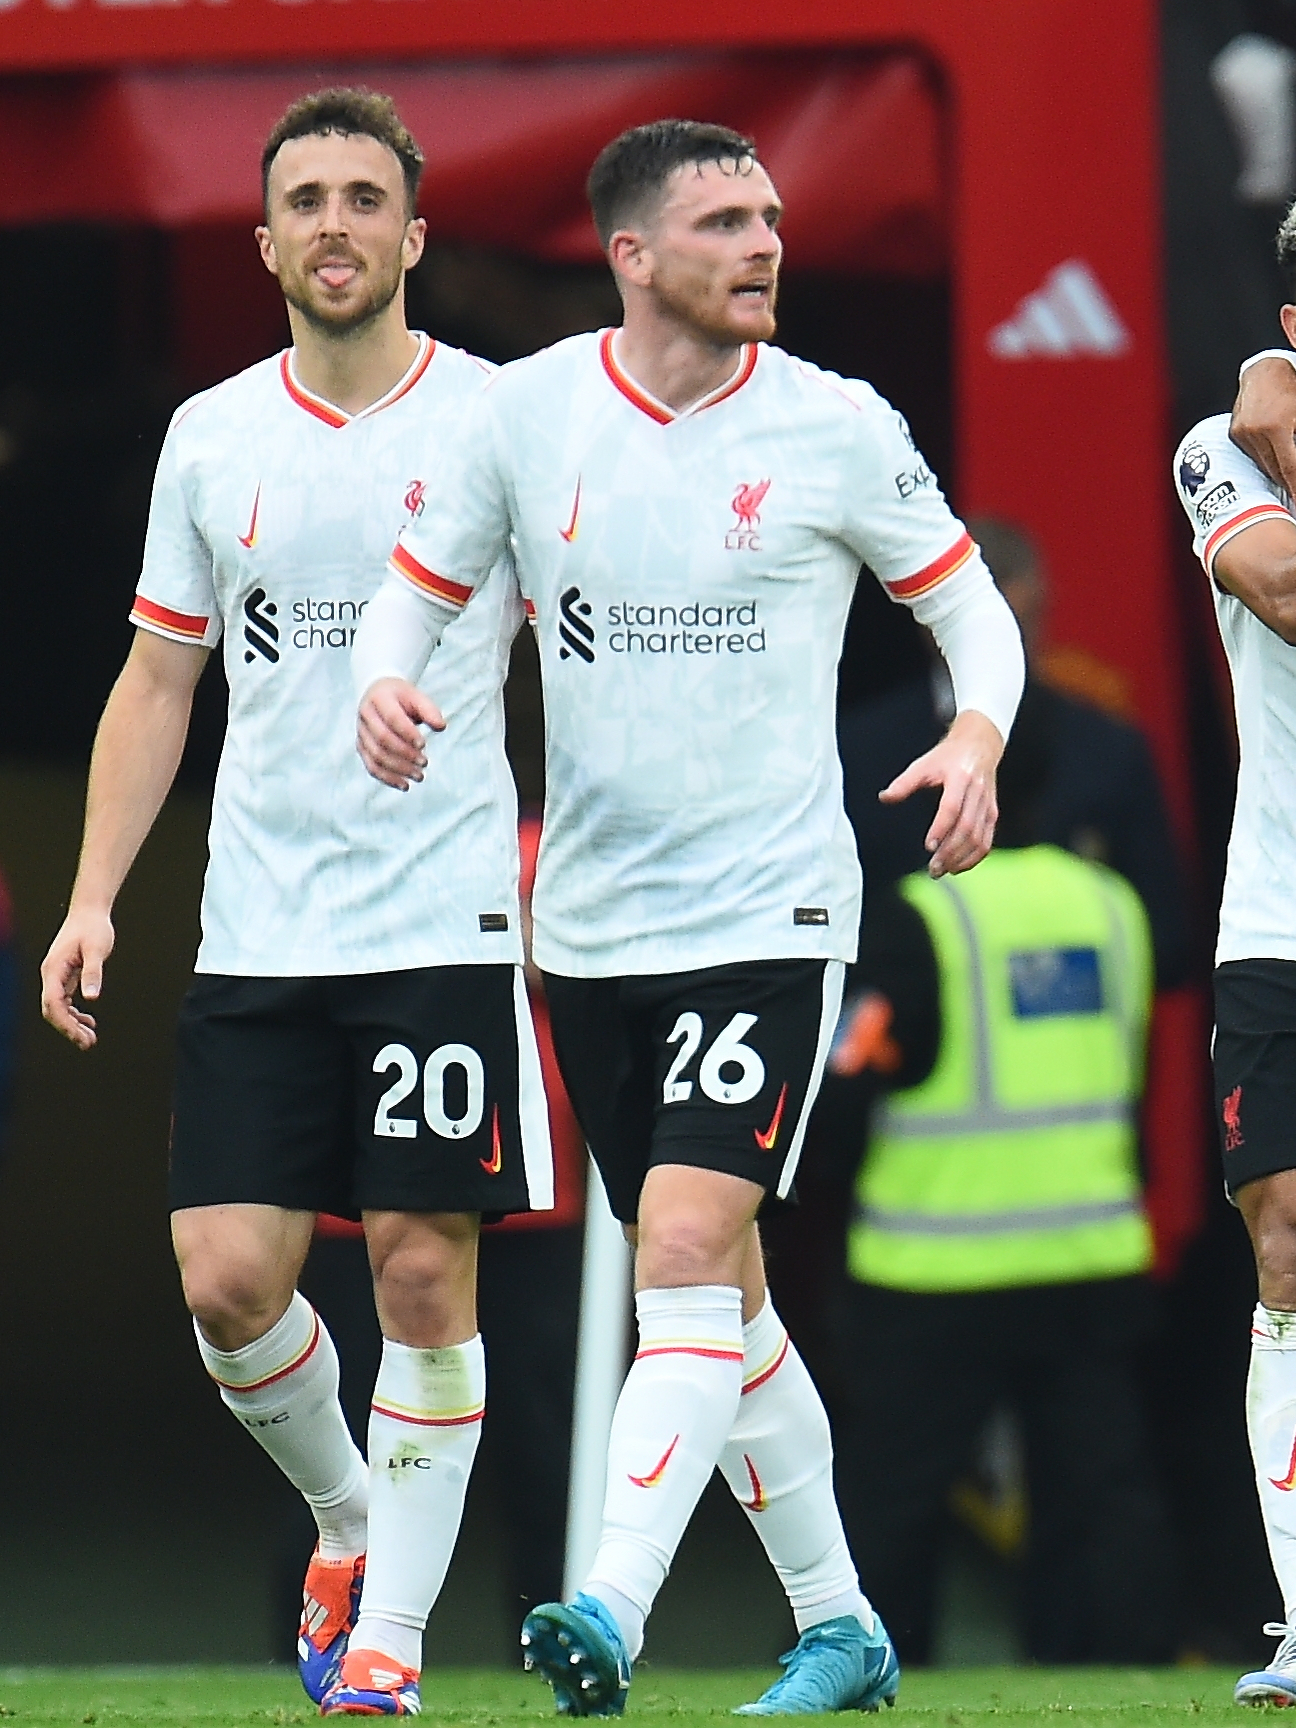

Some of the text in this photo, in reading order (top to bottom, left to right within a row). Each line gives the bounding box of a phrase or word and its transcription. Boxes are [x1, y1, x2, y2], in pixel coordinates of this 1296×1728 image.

[724, 535, 762, 551] LFC
[608, 599, 757, 627] standard
[608, 627, 767, 654] chartered
[663, 1011, 765, 1104] 26
[372, 1043, 485, 1140] 20
[388, 1457, 432, 1470] LFC
